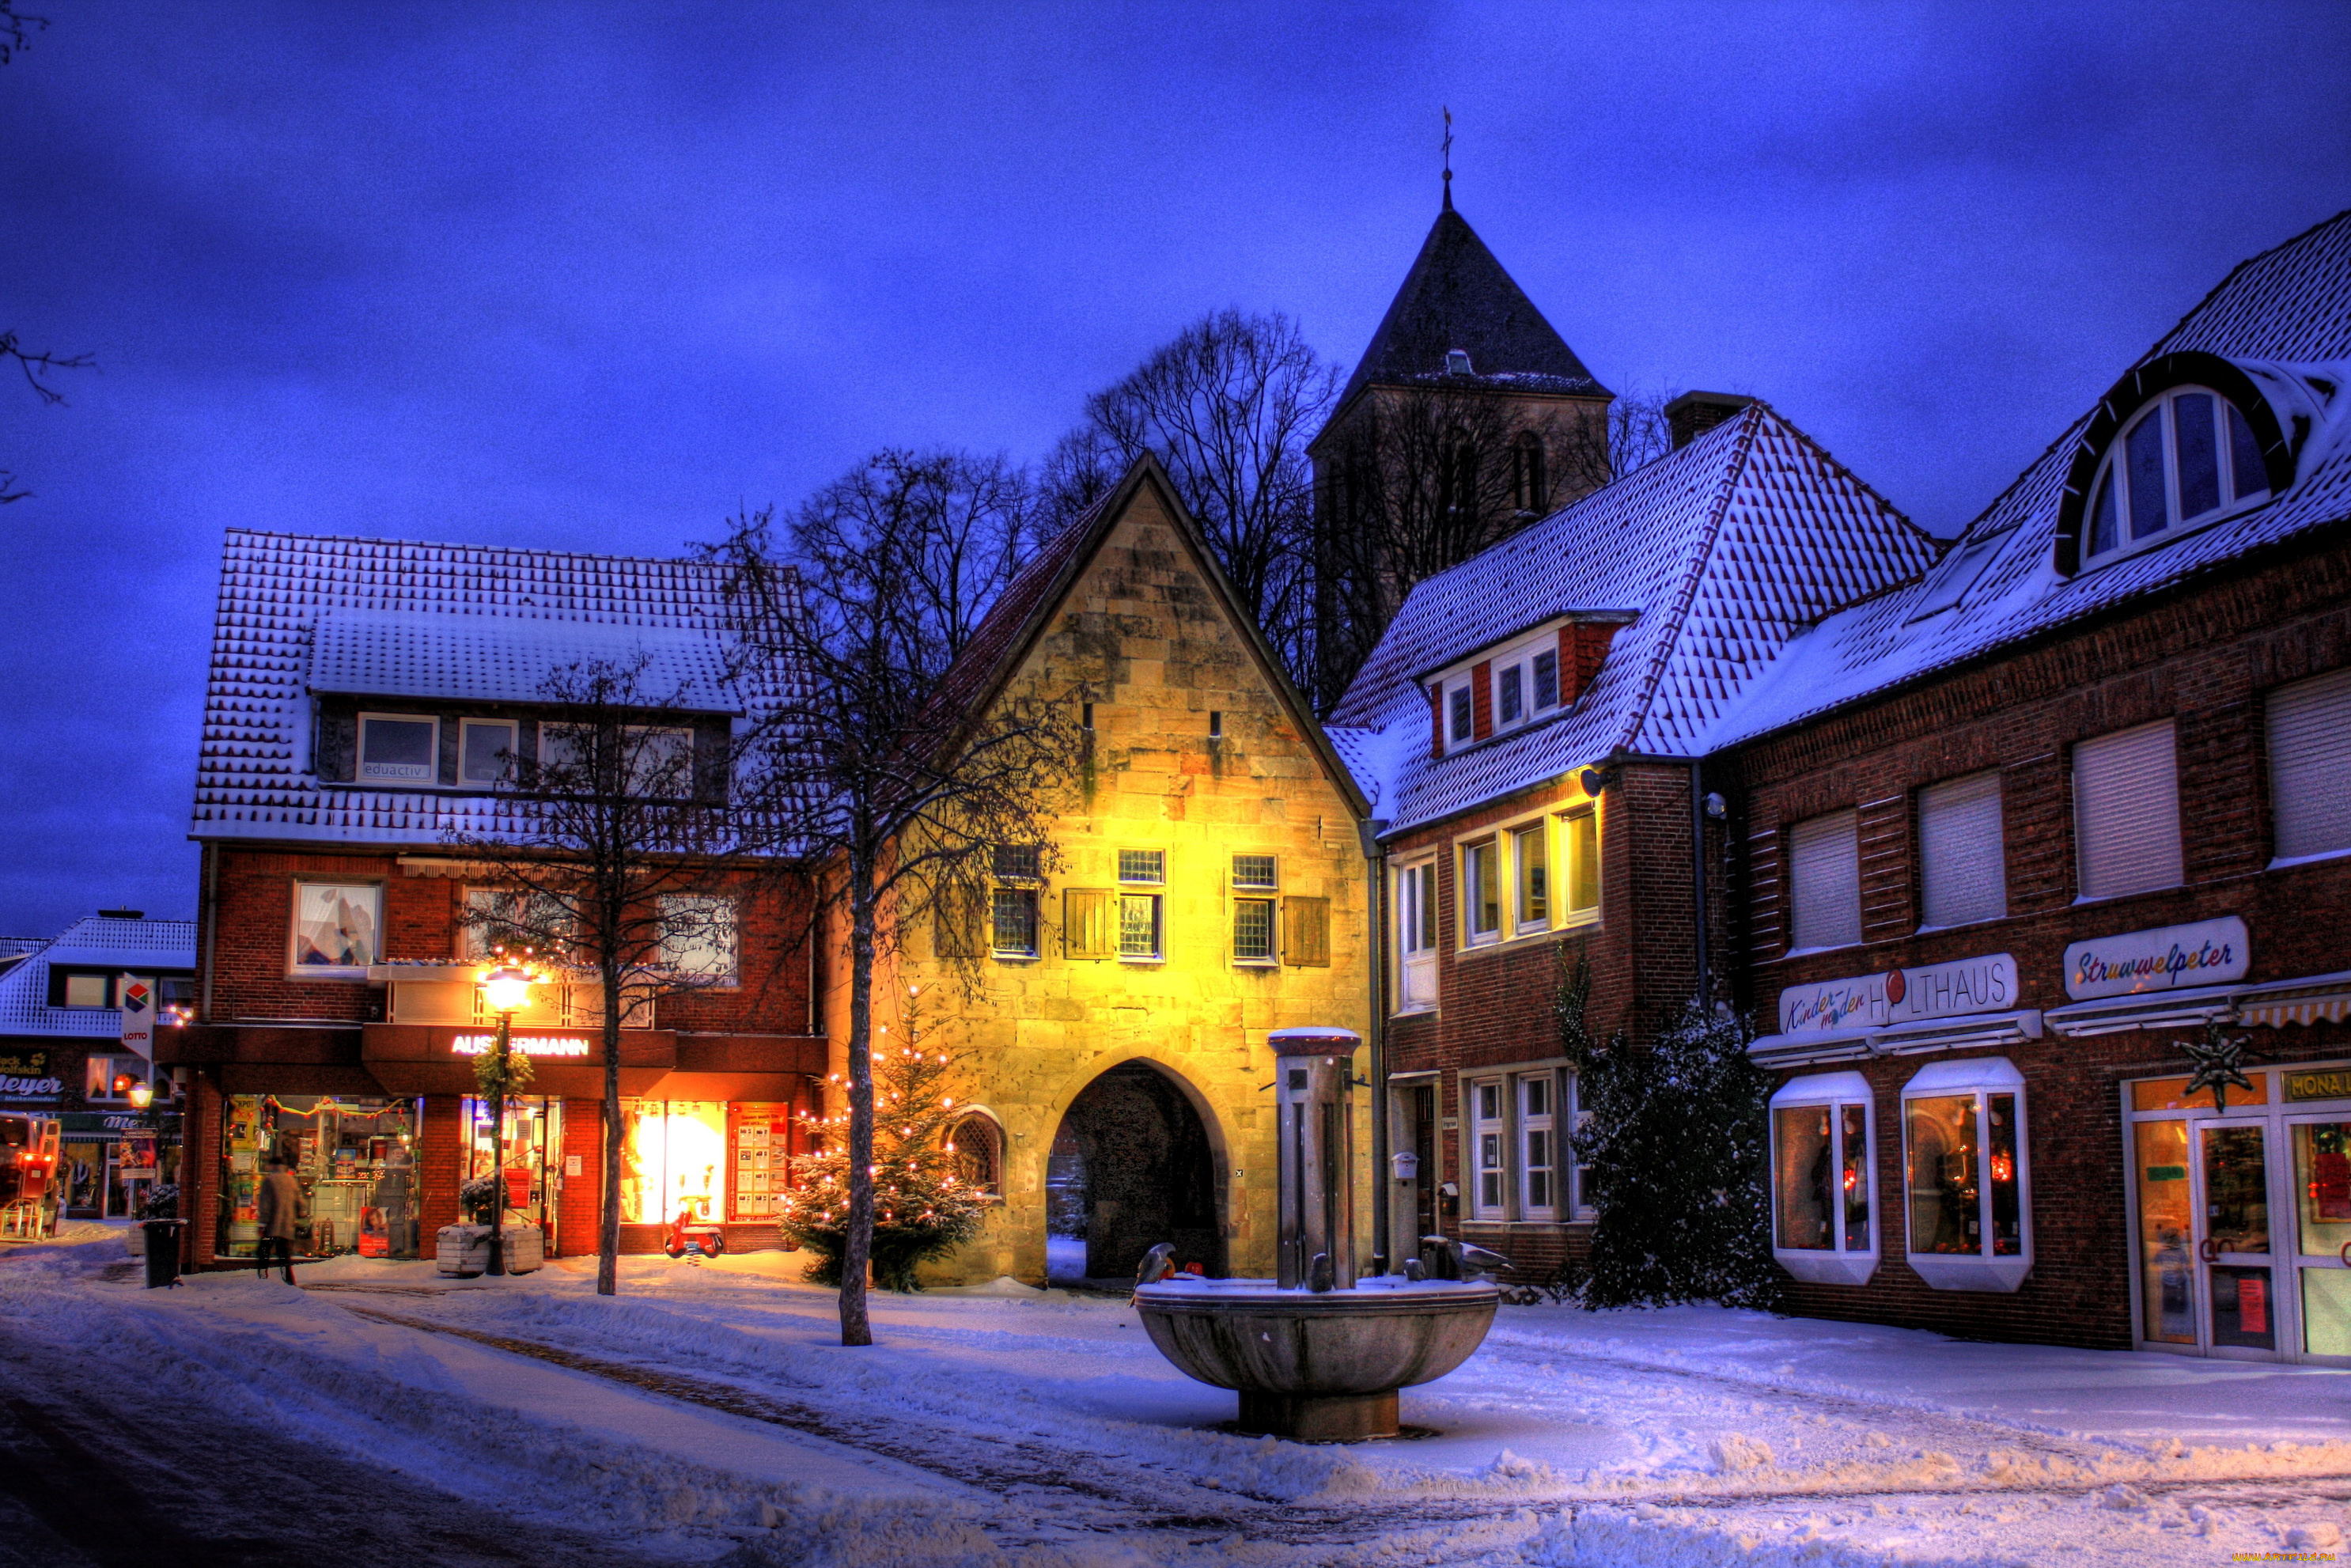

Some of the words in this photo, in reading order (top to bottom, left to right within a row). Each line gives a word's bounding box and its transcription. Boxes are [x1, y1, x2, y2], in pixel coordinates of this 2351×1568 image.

[365, 763, 421, 775] eduactiv
[2076, 940, 2232, 985] Struwwelpeter
[1785, 987, 1844, 1033] Kinder-
[452, 1035, 589, 1055] AUSERMANN
[0, 1055, 21, 1066] ack
[2290, 1075, 2339, 1096] MONA
